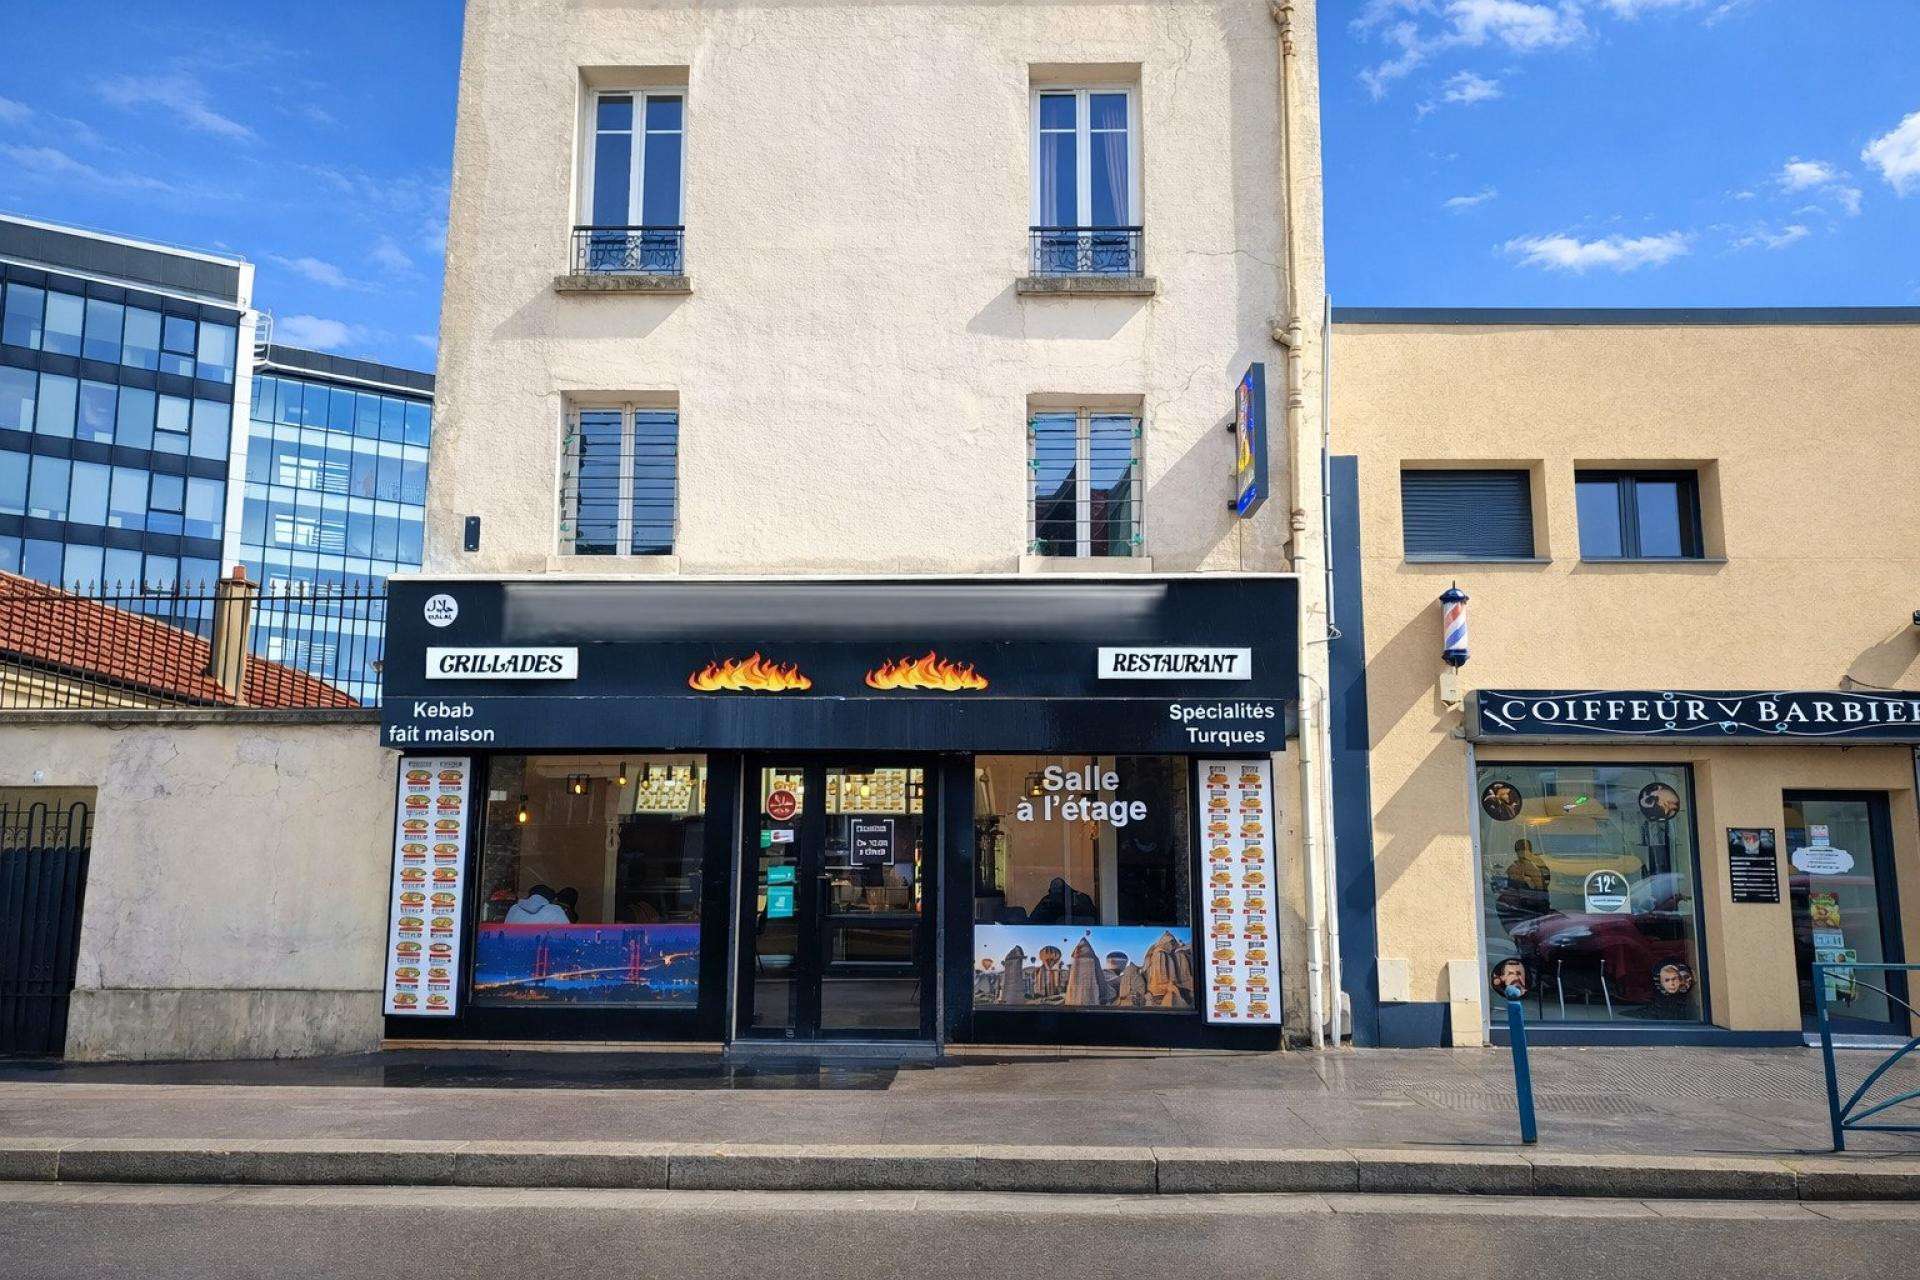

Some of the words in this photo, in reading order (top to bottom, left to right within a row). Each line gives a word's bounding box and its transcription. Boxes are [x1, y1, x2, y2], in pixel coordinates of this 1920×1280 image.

[439, 654, 563, 673] GRILLADES
[1112, 653, 1238, 673] RESTAURANT
[413, 702, 474, 718] Kebab
[1169, 703, 1275, 723] Spécialités
[1501, 700, 1710, 721] COIFFEUR
[389, 725, 419, 742] fait
[425, 727, 495, 742] maison
[1186, 727, 1265, 746] Turques
[1043, 765, 1120, 791] Salle
[1016, 796, 1034, 822] à
